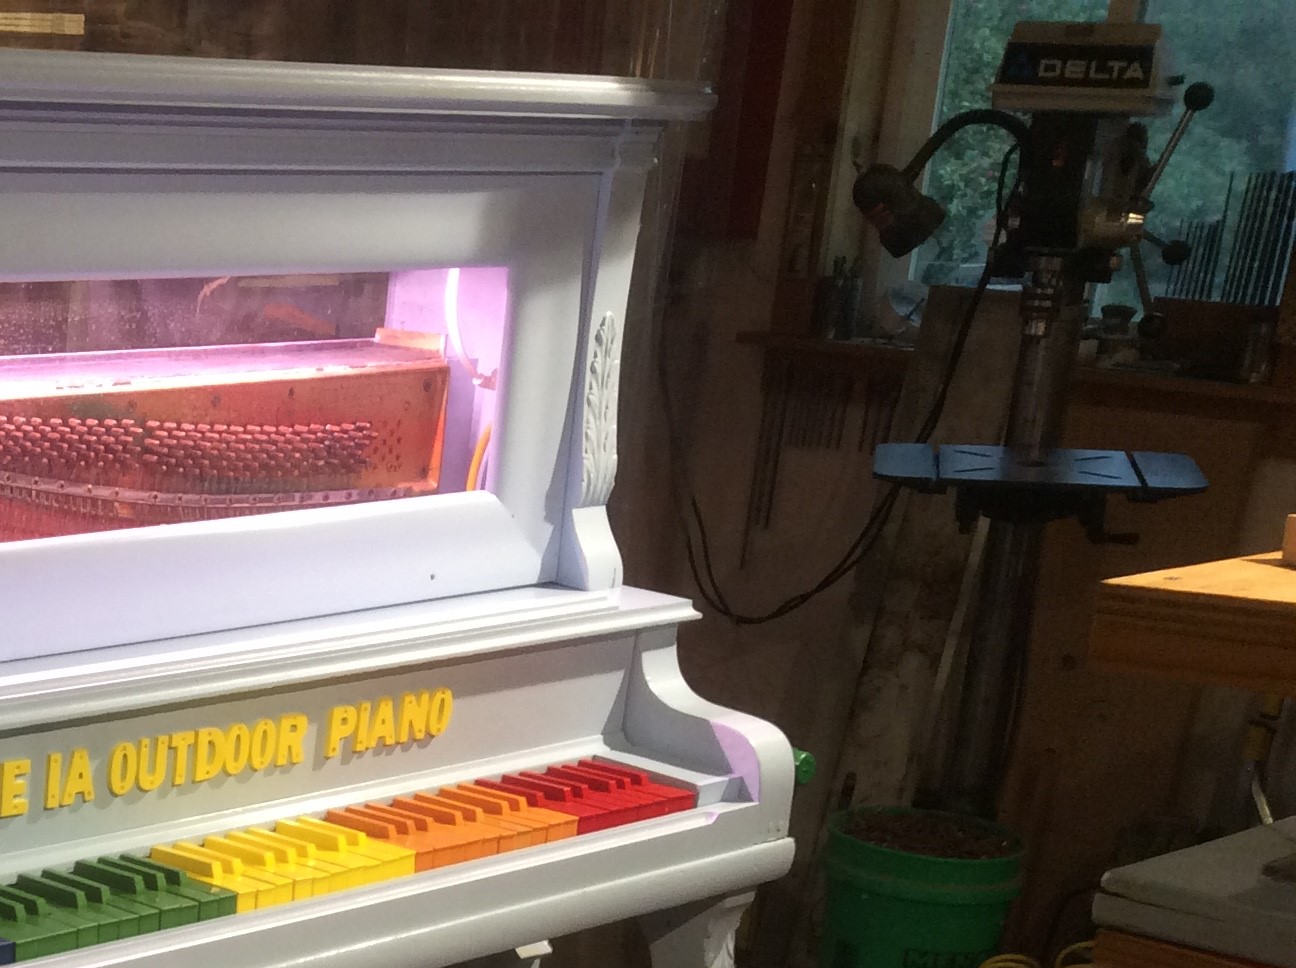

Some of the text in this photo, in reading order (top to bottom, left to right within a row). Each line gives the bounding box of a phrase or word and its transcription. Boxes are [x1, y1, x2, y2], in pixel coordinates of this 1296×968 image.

[1037, 58, 1145, 79] DELTA
[44, 748, 95, 809] IA
[107, 713, 309, 797] OUTDOOR
[324, 687, 454, 759] PIANO
